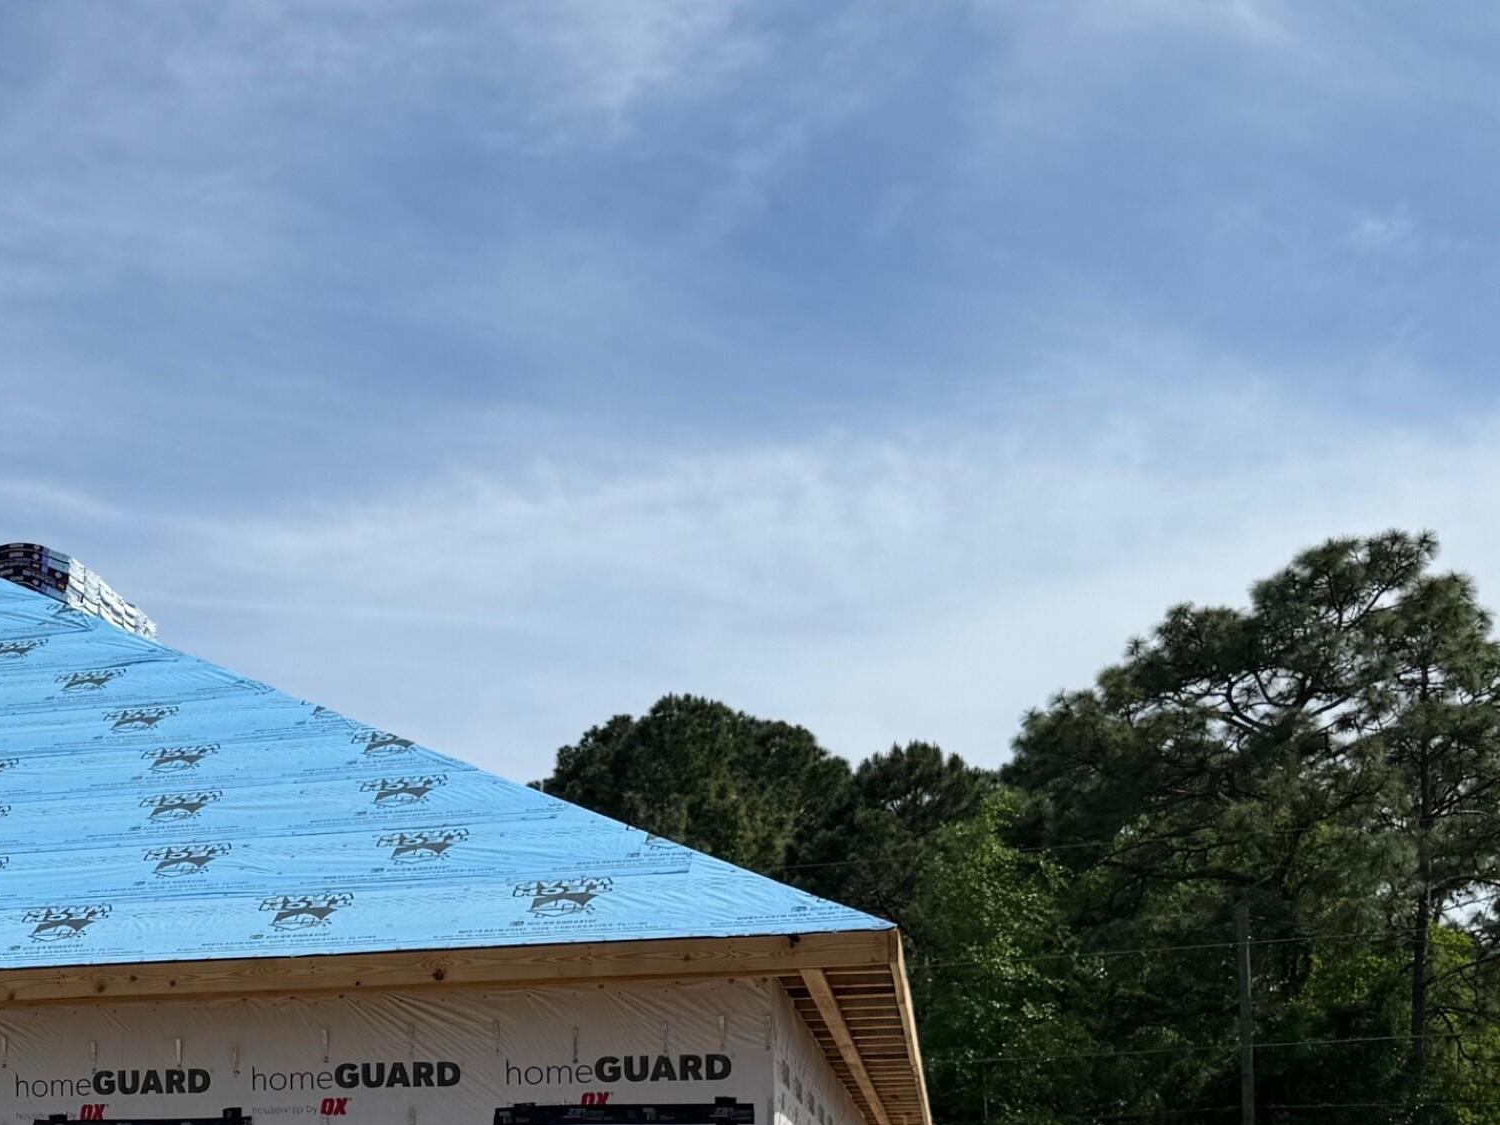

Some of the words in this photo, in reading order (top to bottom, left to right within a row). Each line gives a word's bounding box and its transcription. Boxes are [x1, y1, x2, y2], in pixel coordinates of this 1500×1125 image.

[15, 1069, 211, 1097] homeGUARD
[252, 1061, 461, 1091] homeGUARD
[506, 1054, 732, 1085] homeGUARD
[80, 1104, 105, 1120] OX
[320, 1098, 348, 1115] OX
